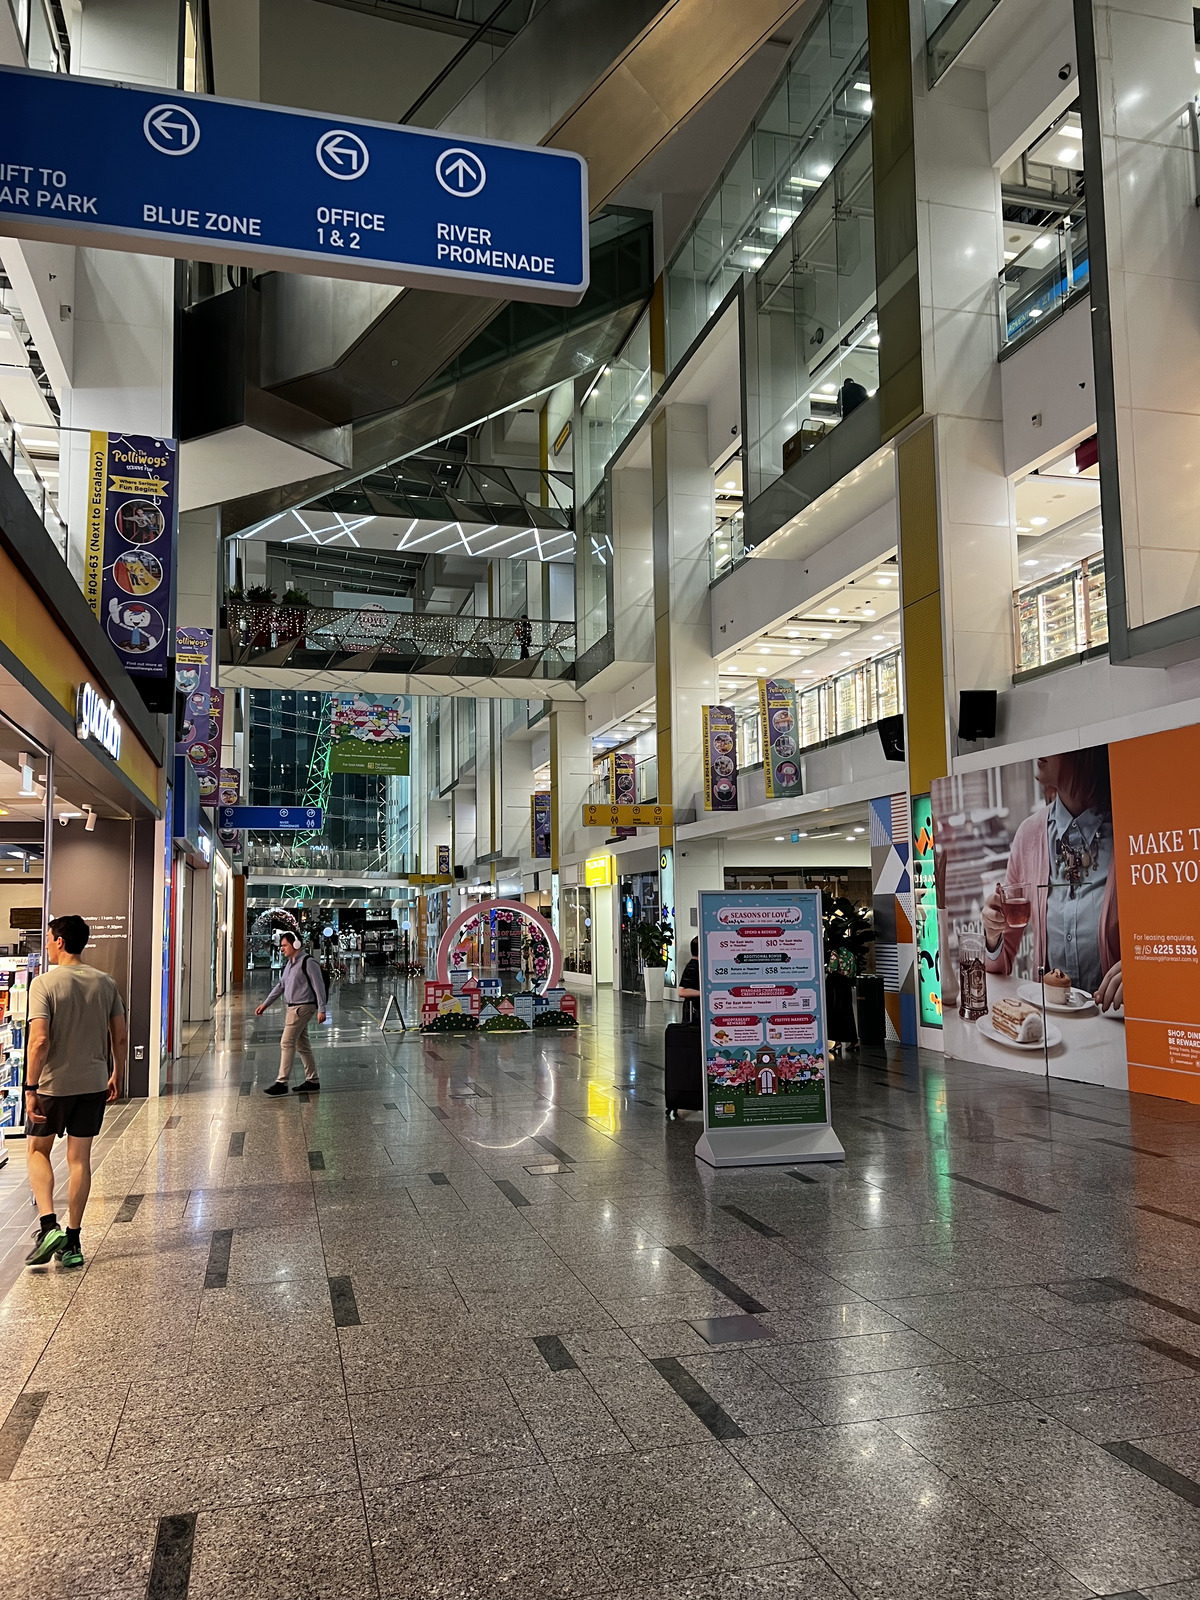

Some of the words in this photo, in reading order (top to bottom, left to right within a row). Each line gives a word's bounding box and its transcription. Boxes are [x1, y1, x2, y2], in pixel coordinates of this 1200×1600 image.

[39, 168, 67, 188] TO
[37, 190, 98, 215] PARK
[143, 204, 200, 229] BLUE
[205, 212, 262, 236] ZONE
[316, 207, 385, 232] OFFICE
[317, 228, 324, 245] 1
[329, 230, 345, 248] &
[349, 232, 360, 249] 2
[437, 223, 492, 246] RIVER
[437, 244, 555, 275] PROMENADE
[111, 449, 168, 468] Polliwogs
[92, 452, 104, 504] Escalator)
[91, 508, 100, 520] to
[90, 521, 101, 552] (Next
[88, 556, 99, 594] #04-63
[88, 596, 96, 609] at
[1128, 830, 1184, 856] MAKE
[1130, 862, 1169, 886] FOR
[1171, 859, 1200, 884] YO
[730, 911, 761, 919] SEASONS
[765, 939, 778, 947] $10
[1133, 933, 1143, 941] For
[1144, 933, 1165, 943] leasing
[1153, 944, 1174, 955] 6225
[1175, 944, 1198, 955] 5336
[764, 966, 779, 974] $38
[714, 1002, 723, 1010] $5
[1167, 1029, 1187, 1039] SHOP,
[1168, 1037, 1176, 1045] BE
